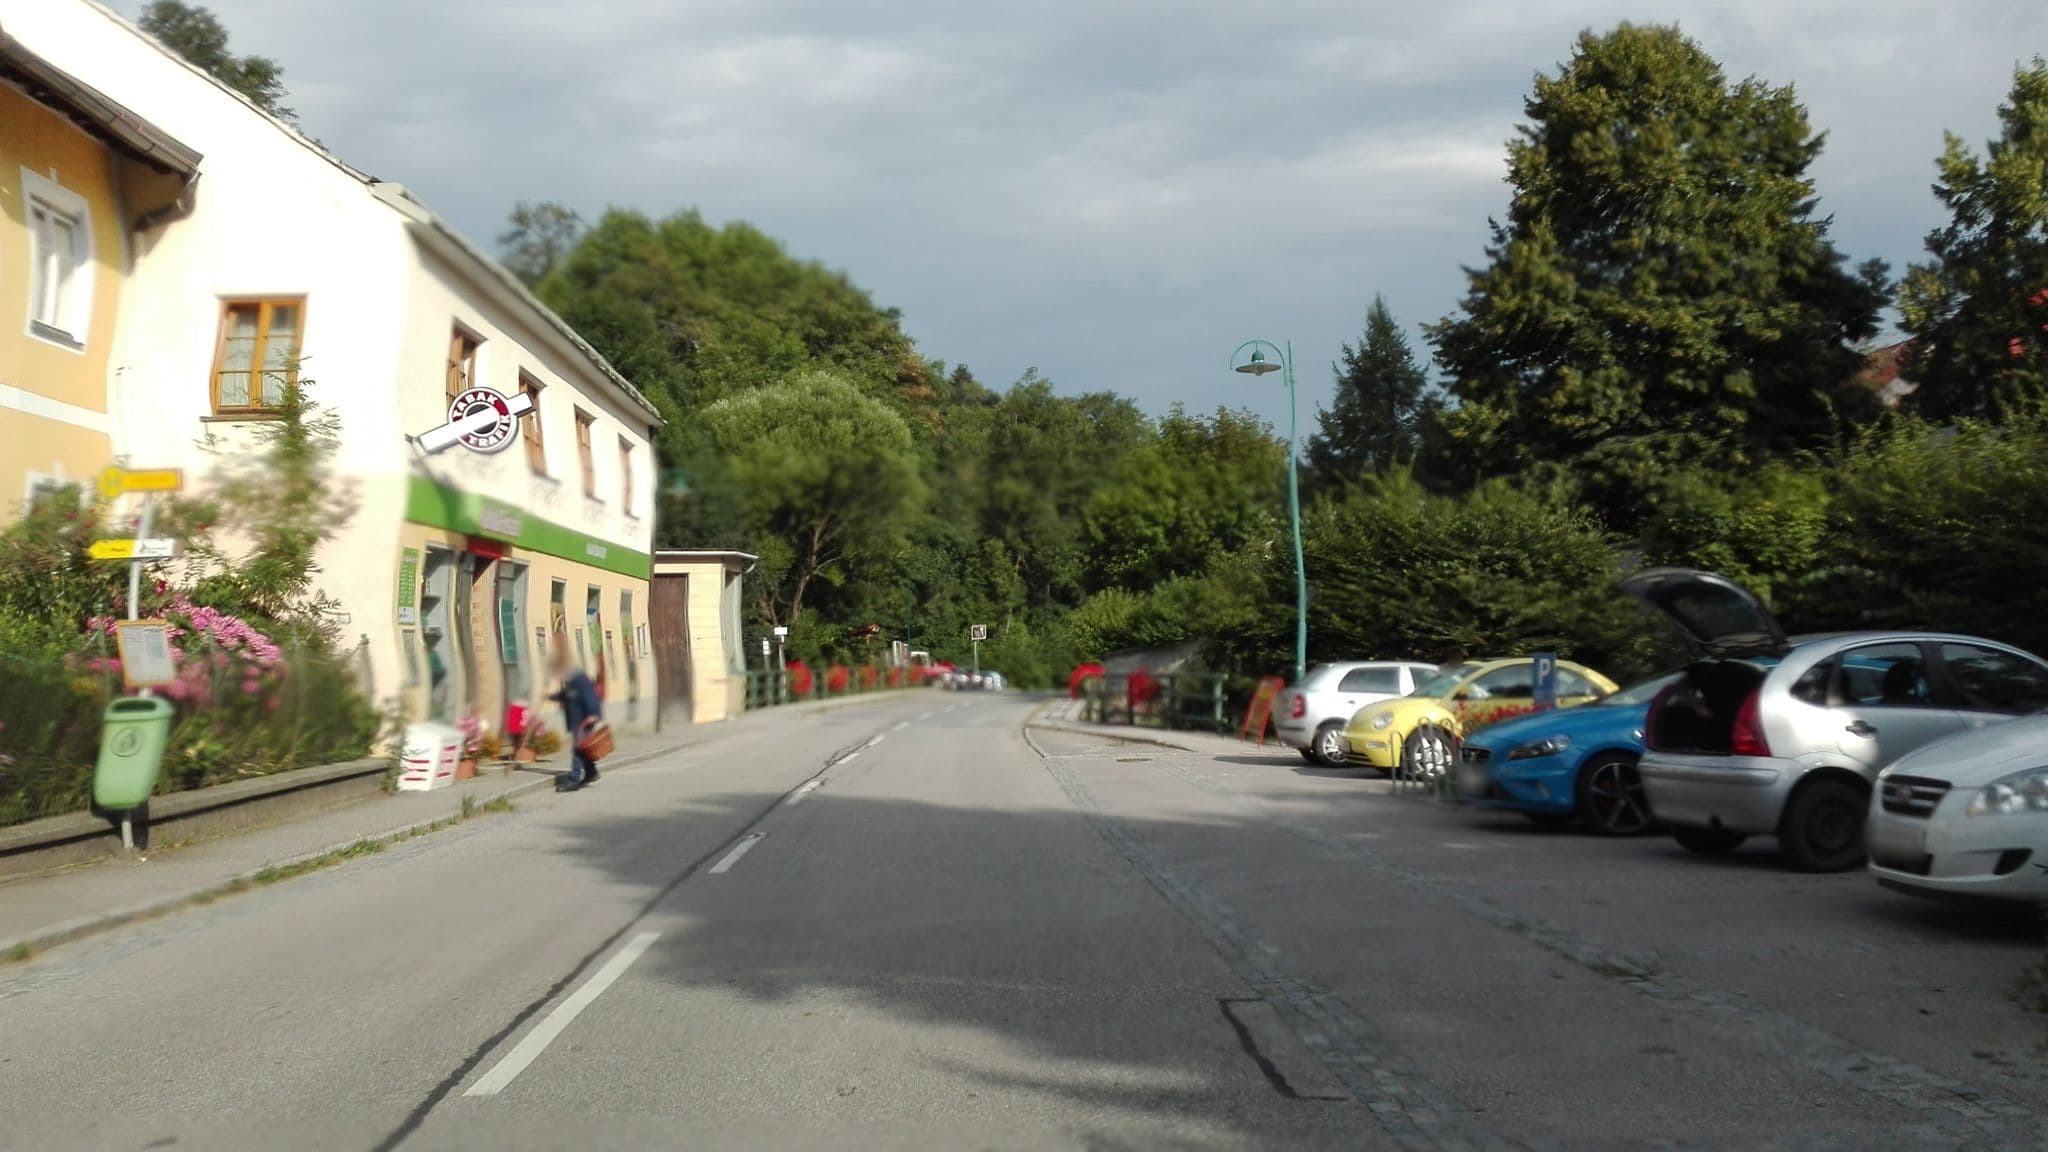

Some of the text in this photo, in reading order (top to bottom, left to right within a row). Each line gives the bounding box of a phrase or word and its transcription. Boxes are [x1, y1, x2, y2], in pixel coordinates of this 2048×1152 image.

[453, 391, 498, 418] TABAK
[468, 415, 510, 447] TRAFIK
[1539, 659, 1551, 686] P
